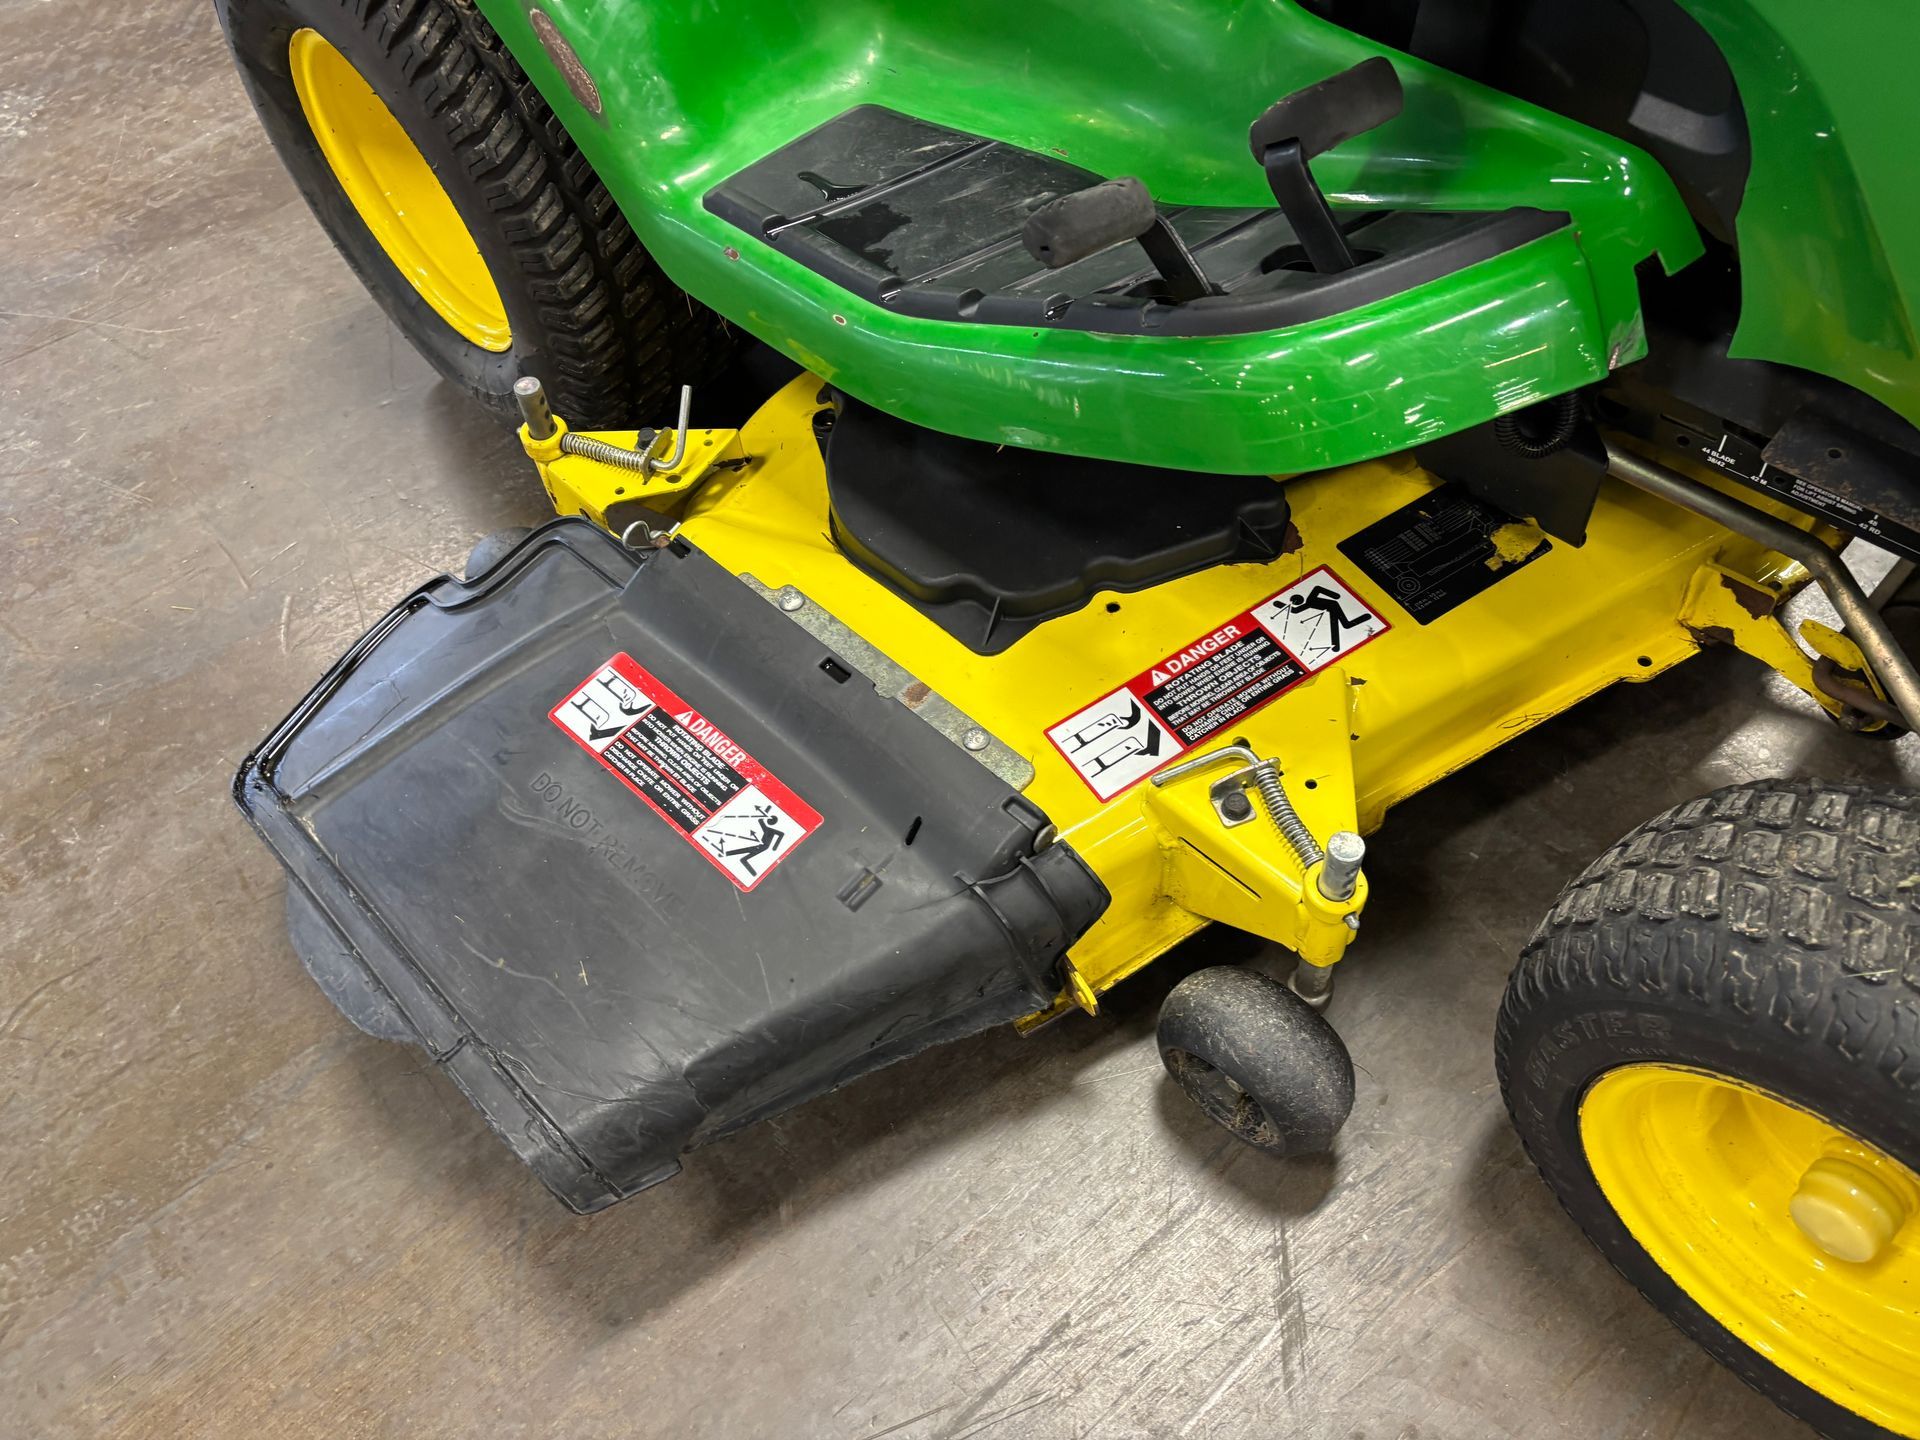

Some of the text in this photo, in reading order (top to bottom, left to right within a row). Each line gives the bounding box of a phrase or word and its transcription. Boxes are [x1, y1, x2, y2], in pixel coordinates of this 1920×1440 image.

[1711, 451, 1735, 464] BLADE
[1791, 490, 1826, 506] ADJUSTMENT
[1816, 495, 1836, 505] ASSIST
[1841, 499, 1862, 511] MANUAL
[1153, 698, 1164, 706] DO
[1163, 689, 1176, 700] NOT
[1176, 682, 1189, 692] PUT
[1189, 670, 1211, 684] HANDS
[1219, 654, 1235, 666] FEET
[1234, 642, 1256, 656] UNDER
[1165, 625, 1241, 673] DANGER
[1165, 641, 1244, 690] ROTATING BLADE
[1157, 699, 1173, 710] INTO
[1172, 685, 1196, 701] MOWER
[1195, 674, 1215, 687] WHEN
[1214, 661, 1237, 676] ENGINE
[1168, 705, 1191, 721] BEFORE
[1189, 692, 1216, 707] MOWING,
[1214, 680, 1234, 693] CLEAR
[1233, 671, 1249, 682] AREA
[1255, 651, 1281, 667] OBJECTS
[1172, 714, 1188, 725] THAT
[1188, 706, 1201, 716] MAY
[1210, 685, 1237, 702] THROWN
[1235, 679, 1245, 687] BY
[1244, 667, 1266, 681] BLADE
[1176, 654, 1261, 706] THROWN OBJECTS
[1182, 665, 1291, 733] DO NOT OPERATE MOWER WITHOUT
[1185, 713, 1221, 737] DISCHARGE
[1221, 701, 1242, 715] CHUTE
[1251, 682, 1273, 697] ENTIRE
[1272, 669, 1294, 683] GRASS
[642, 718, 654, 728] INTO
[652, 727, 671, 743] MOWER
[670, 741, 685, 754] WHEN
[683, 753, 702, 769] ENGINE
[672, 725, 725, 769] ROTATING BLADE
[688, 718, 746, 767] DANGER
[1189, 721, 1219, 740] CATCHER
[1225, 704, 1247, 719] PLACE
[604, 751, 626, 770] CATCHER
[629, 772, 645, 787] PLACE
[614, 741, 705, 819] DO NOT OPERATE MOWER WITHOUT
[626, 732, 639, 743] THAT
[637, 742, 648, 751] MAY
[654, 755, 675, 774] THROWN
[679, 778, 697, 793] BLADE
[631, 728, 649, 743] BEFORE
[667, 758, 683, 772] CLEAR
[681, 771, 695, 782] AREA
[700, 787, 722, 805] OBJECTS
[655, 720, 667, 730] NOT
[666, 729, 677, 738] PUT
[676, 737, 693, 752] HANDS
[693, 751, 702, 759] OR
[701, 757, 714, 769] FEET
[713, 769, 731, 784] UNDER
[730, 783, 739, 791] OR
[655, 736, 710, 785] THROWN OBJECTS
[530, 772, 563, 802] DO
[556, 796, 603, 836] NOT
[609, 746, 699, 825] DISCHARGE CHUTE OR ENTIRE GRASS
